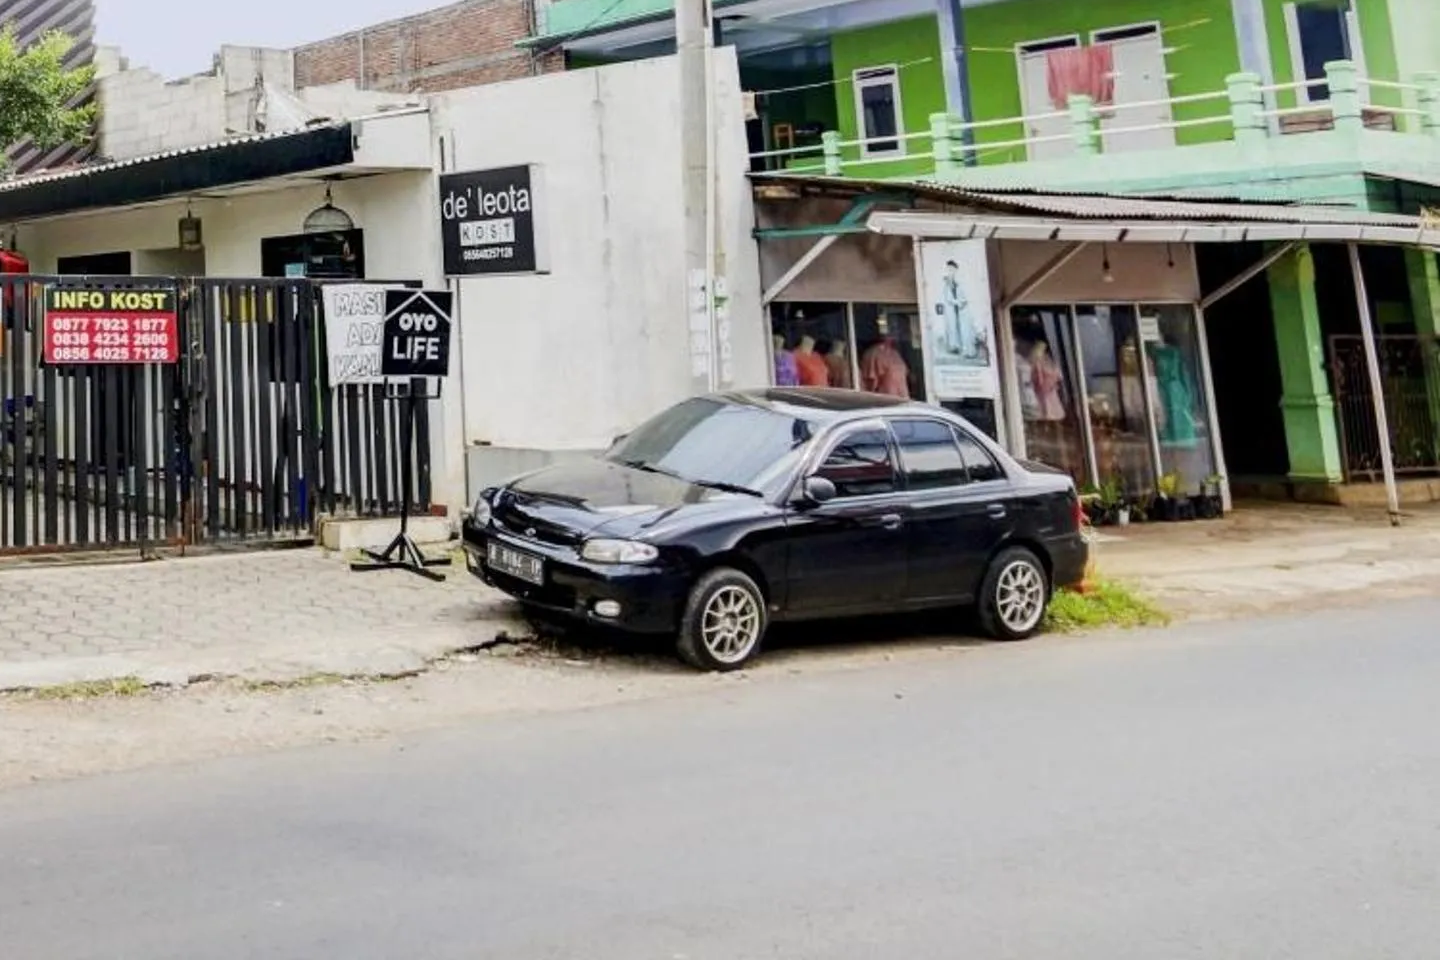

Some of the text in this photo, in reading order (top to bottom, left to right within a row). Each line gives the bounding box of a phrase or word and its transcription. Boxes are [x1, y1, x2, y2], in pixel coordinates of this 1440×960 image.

[462, 222, 511, 241] KOST
[53, 291, 167, 310] INFO KOST
[53, 318, 89, 331] 0877
[133, 318, 168, 331] 1877
[399, 312, 438, 331] OYO
[53, 347, 90, 360] 0856
[93, 347, 129, 360] 4025
[392, 336, 440, 362] LIFE
